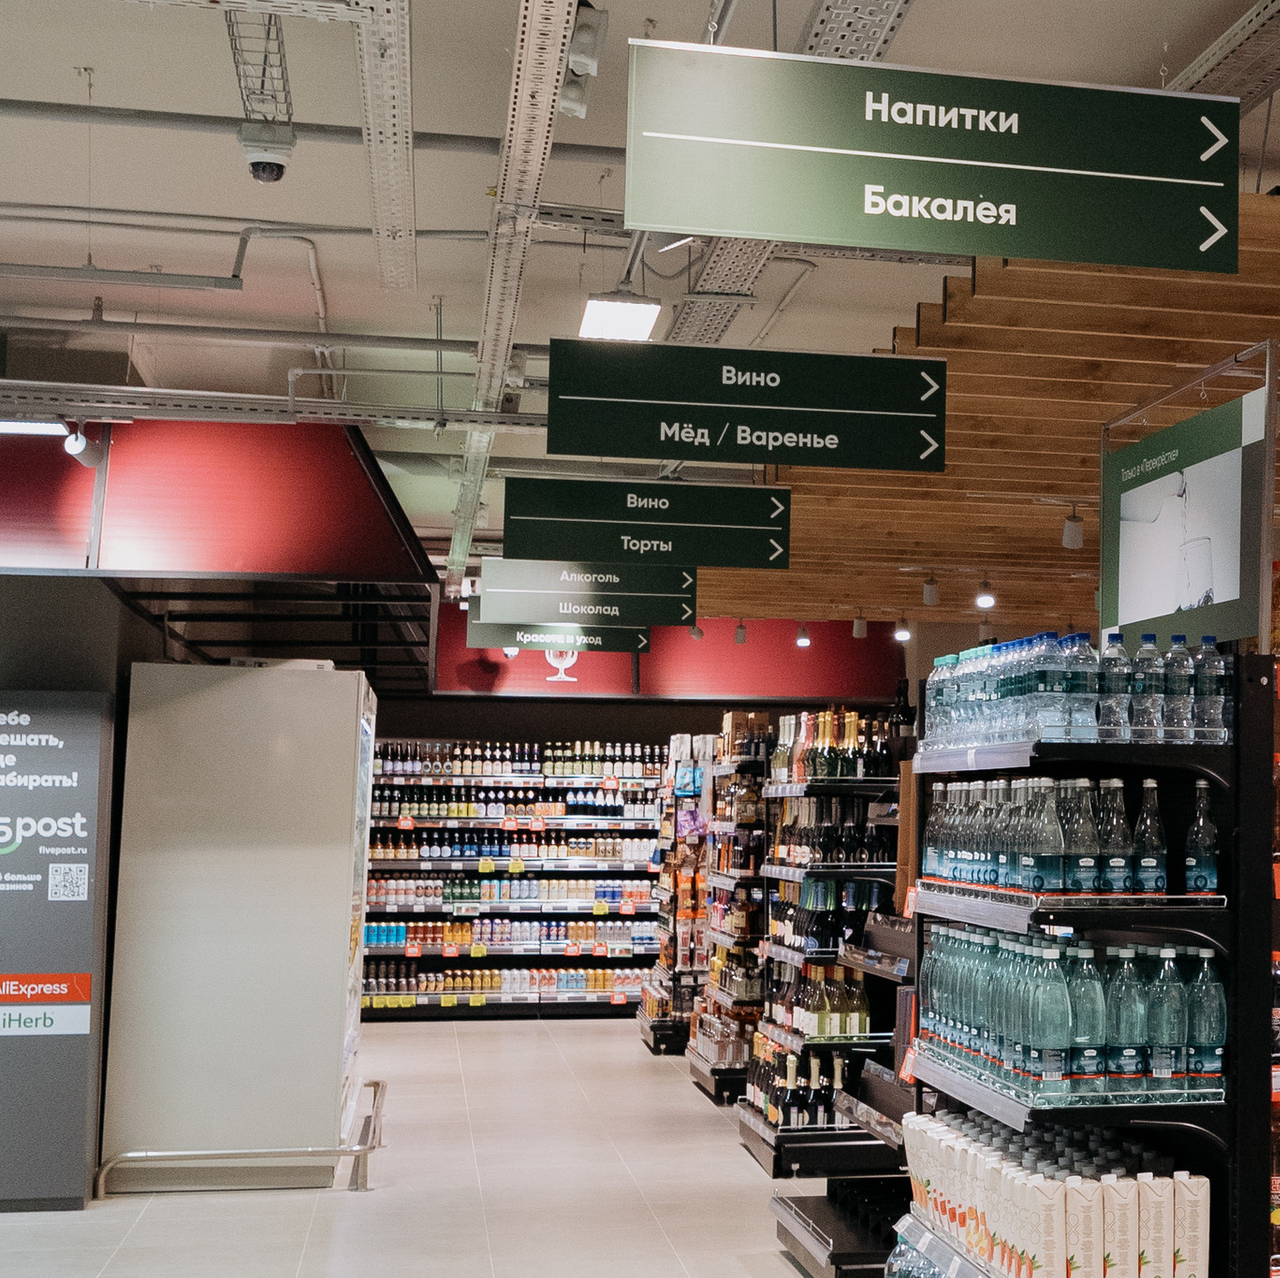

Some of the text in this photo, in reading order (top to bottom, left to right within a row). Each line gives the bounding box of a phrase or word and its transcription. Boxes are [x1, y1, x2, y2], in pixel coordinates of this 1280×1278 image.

[865, 91, 1019, 134] Напитки
[864, 183, 1017, 225] Бакалея
[722, 365, 781, 387] Вино
[660, 421, 839, 450] Мёд / Варенье
[627, 493, 669, 509] Вино
[620, 536, 673, 554] Торты
[560, 571, 620, 583] Алкоголь
[559, 602, 620, 616] Шоколад
[576, 635, 602, 646] уход
[0, 733, 64, 749] ешать,
[39, 845, 87, 855] fivepost.ru
[3, 1011, 54, 1028] iHerb
